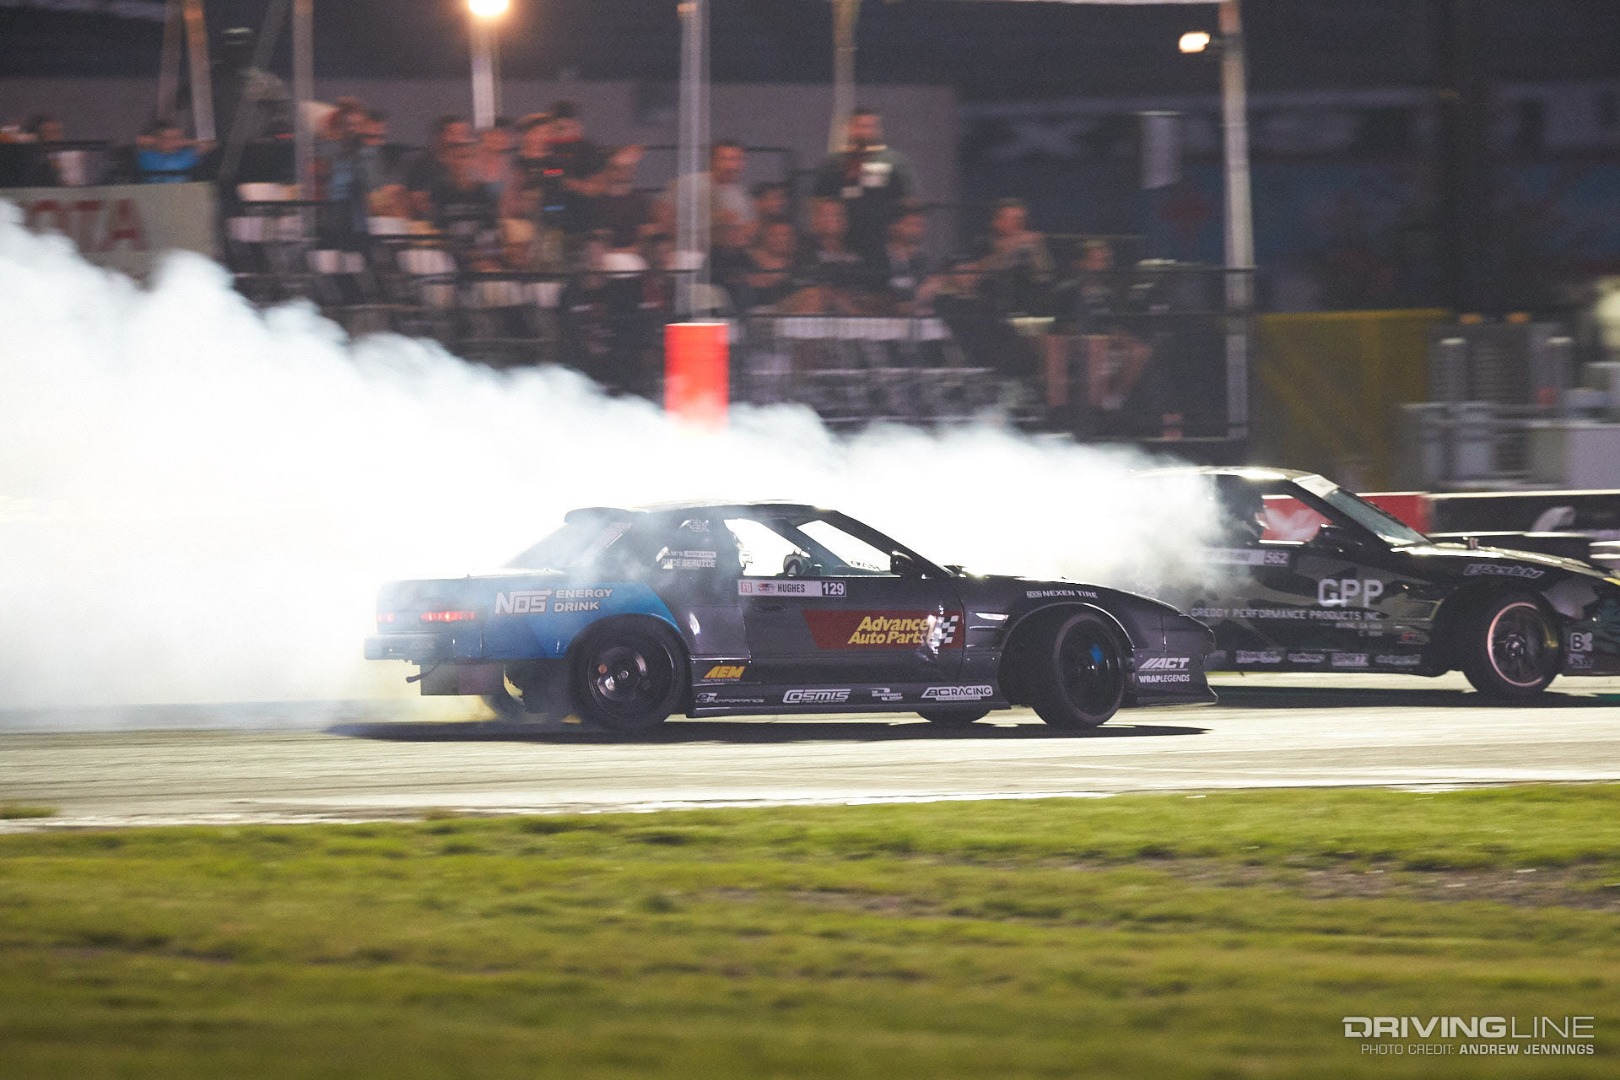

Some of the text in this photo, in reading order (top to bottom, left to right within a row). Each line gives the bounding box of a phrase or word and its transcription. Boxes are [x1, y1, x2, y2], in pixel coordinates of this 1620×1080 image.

[556, 589, 613, 599] ENERGY
[778, 584, 806, 593] HUGHES
[823, 583, 845, 595] 129
[1076, 590, 1098, 599] TIRE
[1318, 578, 1384, 608] GPP
[495, 588, 553, 614] NOS
[554, 601, 600, 612] DRINK
[1233, 609, 1305, 619] PERFORMANCE
[1309, 611, 1362, 620] PRODUCTS
[857, 616, 931, 631] Advance
[848, 631, 927, 644] Auto Parts
[704, 665, 746, 678] AEM
